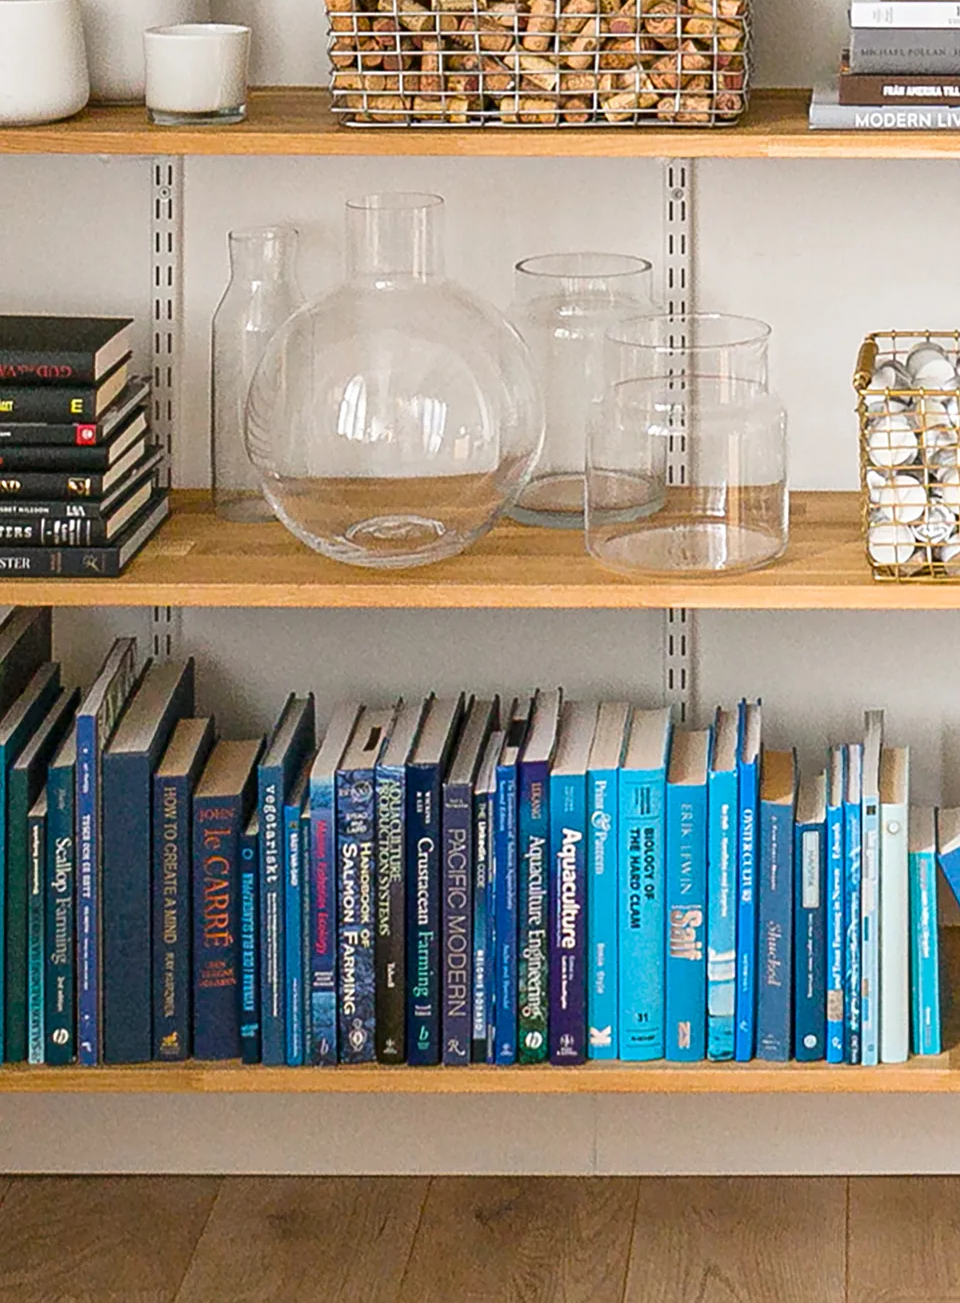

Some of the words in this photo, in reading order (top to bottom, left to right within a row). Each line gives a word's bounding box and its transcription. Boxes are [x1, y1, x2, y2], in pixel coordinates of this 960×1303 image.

[861, 48, 905, 57] MICHAEL
[907, 48, 946, 57] POLLAN
[942, 85, 960, 97] TILL
[855, 112, 932, 127] MODERN
[71, 398, 84, 414] E
[164, 787, 177, 819] HOW
[478, 802, 487, 819] THE
[594, 780, 607, 809] Print
[164, 822, 177, 840] TO
[204, 828, 232, 849] le
[378, 780, 392, 875] PRODUCTION
[389, 780, 403, 882] AQUACULTURE
[591, 810, 612, 831] &
[680, 803, 693, 837] ERIK
[478, 821, 488, 862] LinkedIn
[594, 831, 608, 874] Pattern
[629, 828, 640, 851] THE
[644, 827, 655, 879] BIOLOGY
[53, 837, 73, 892] Scallop
[164, 843, 177, 894] CREATE
[342, 842, 359, 922] SALMON
[360, 842, 373, 924] HANDBOOK
[417, 837, 434, 925] Crustacean
[448, 828, 467, 909] PACIFIC
[477, 863, 487, 888] CODE
[525, 835, 546, 925] Aquaculture
[630, 856, 640, 890] HARD
[164, 897, 177, 908] A
[204, 855, 235, 948] CARRÉ
[379, 875, 393, 936] SYSTEMS
[557, 827, 582, 948] Aquaculture
[644, 884, 655, 900] OF
[831, 901, 840, 910] in
[52, 897, 72, 964] Farming
[164, 909, 177, 944] MIND
[630, 894, 641, 929] CLAM
[832, 912, 842, 947] Farming
[316, 912, 330, 954] Ecology
[360, 929, 371, 948] OF
[165, 952, 175, 970] RAY
[343, 930, 360, 1015] FARMING
[413, 930, 434, 998] Farming
[447, 915, 467, 1017] MODERN
[767, 920, 782, 987] Shucked
[523, 930, 546, 1019] Engineering
